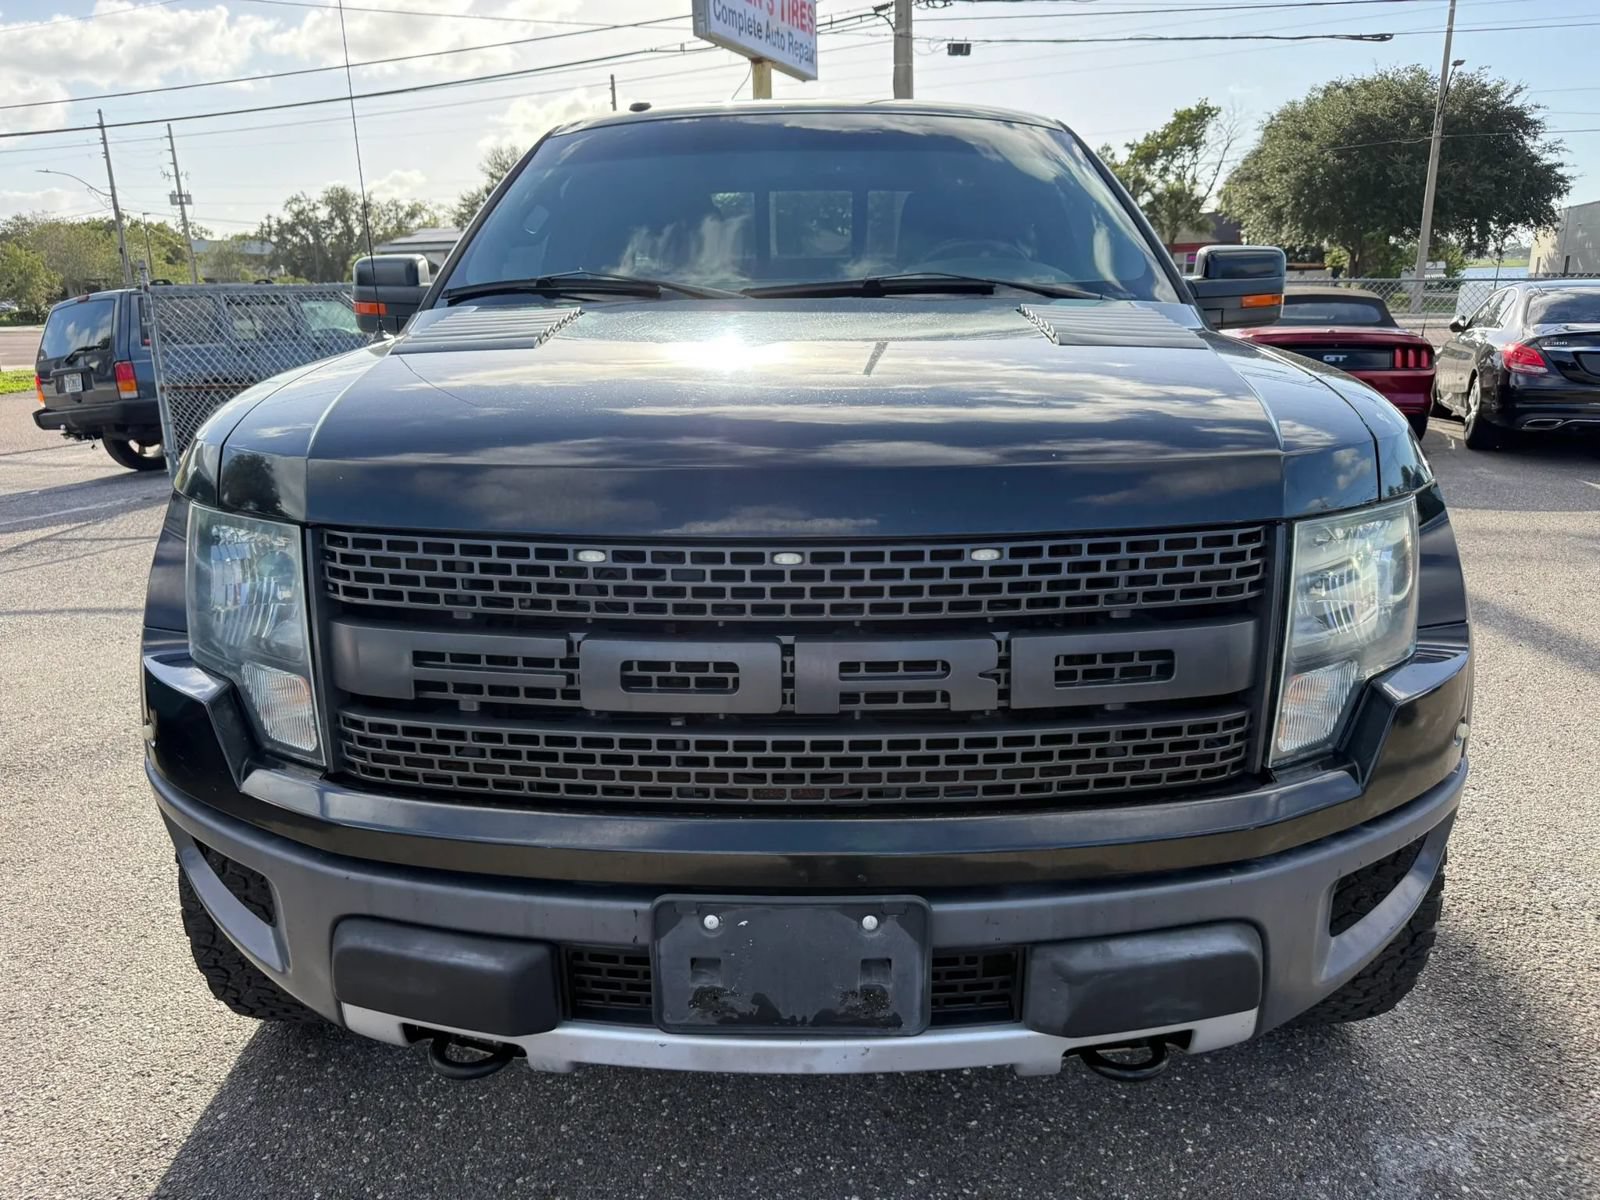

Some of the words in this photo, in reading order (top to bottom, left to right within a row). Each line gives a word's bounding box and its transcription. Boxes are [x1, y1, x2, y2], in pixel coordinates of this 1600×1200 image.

[713, 0, 763, 39] Complete
[765, 20, 785, 51] Auto
[788, 31, 815, 64] Repair
[1323, 354, 1348, 362] GT
[331, 620, 1256, 715] FORD
